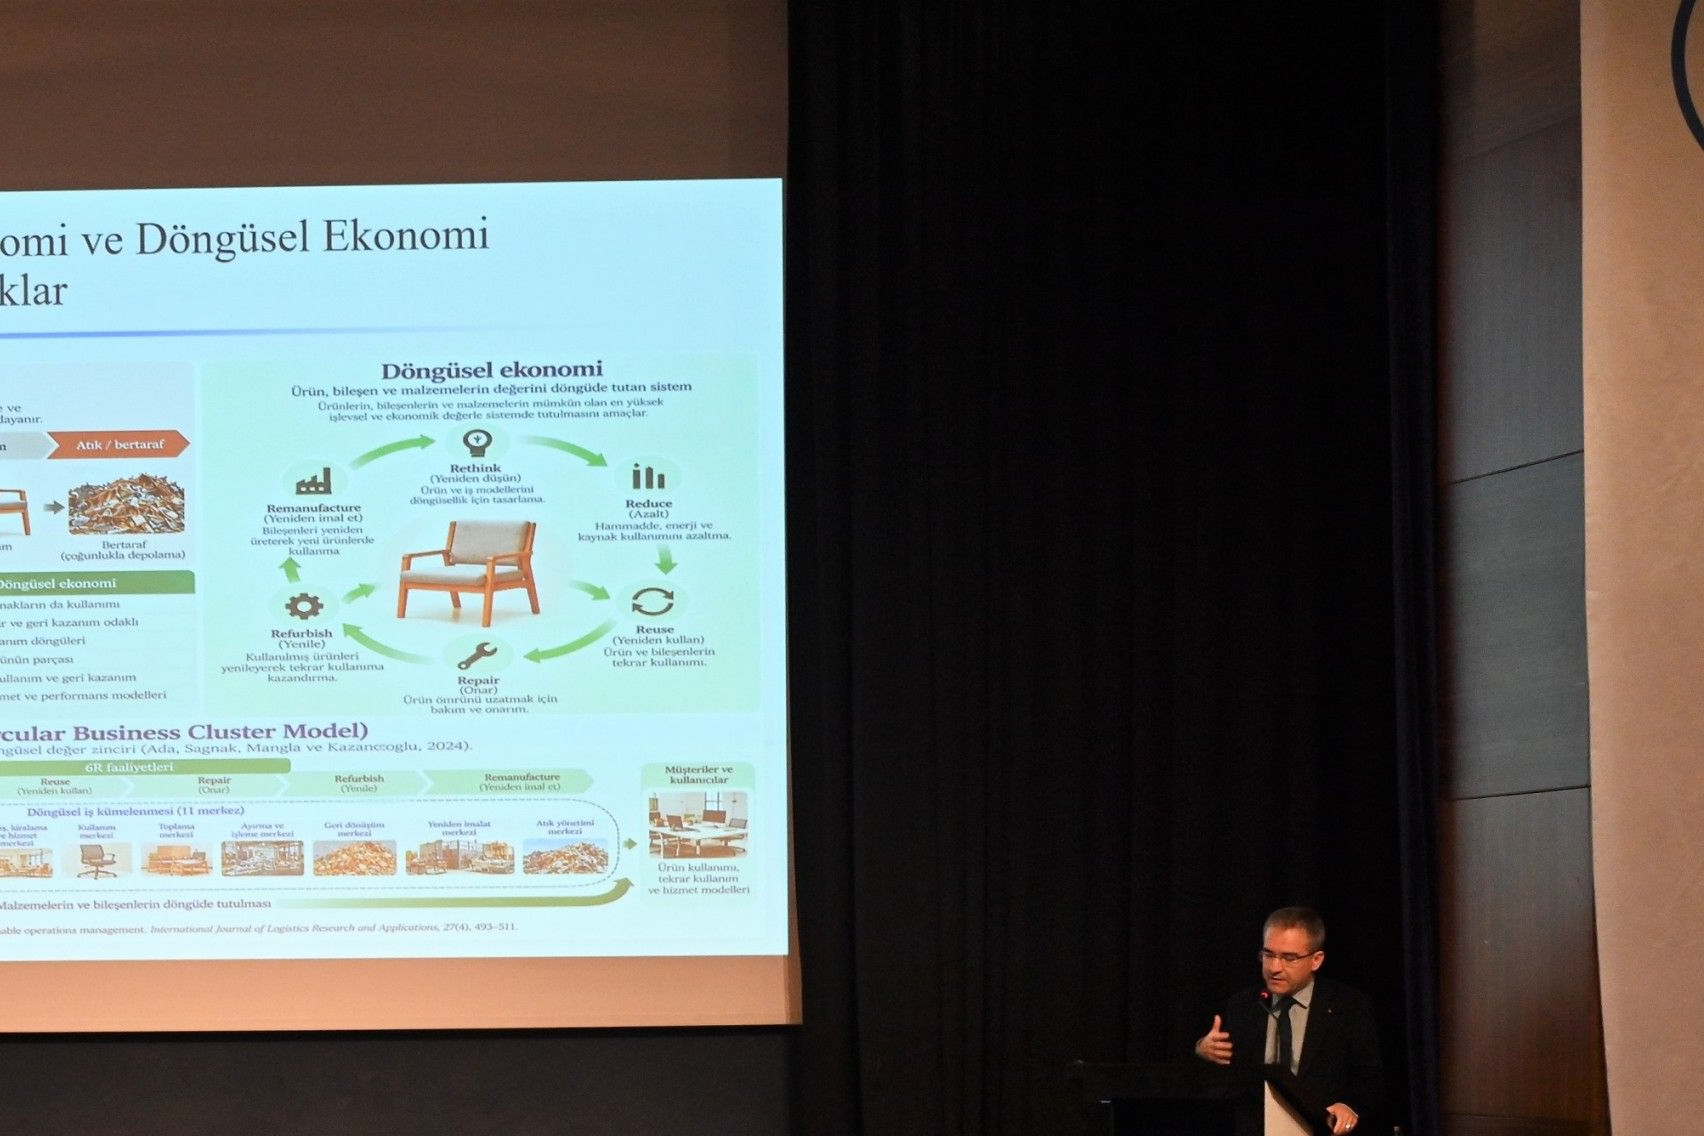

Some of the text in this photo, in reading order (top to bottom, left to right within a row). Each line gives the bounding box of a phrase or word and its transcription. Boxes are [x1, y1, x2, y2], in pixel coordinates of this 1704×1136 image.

[81, 233, 122, 255] ve
[136, 218, 309, 265] Döngüsel
[323, 215, 488, 252] Ekonomi
[382, 359, 603, 384] Döngüsel ekonomi
[291, 381, 692, 398] Ürün, bileşen ve malzemelerin değerini döngüde tutan sistem
[7, 405, 21, 413] ve
[76, 440, 102, 450] Atık
[114, 439, 165, 450] bertaraf
[450, 463, 501, 473] Rethink
[430, 473, 521, 484] (Yeniden düşün)
[267, 502, 361, 513] Remanufacture
[626, 498, 672, 508] Reduce
[263, 513, 363, 525] (Yeniden imal et)
[628, 509, 669, 519] (Azalt)
[102, 540, 147, 549] Bertaraf
[60, 549, 186, 562] (çoğunlukla depolama)
[58, 577, 116, 589] ekonomi
[271, 628, 332, 638] Refurbish
[636, 625, 674, 634] Reuse
[278, 639, 326, 650] (Yenile)
[612, 634, 704, 646] (Yeniden kullan)
[458, 675, 500, 687] Repair
[459, 685, 498, 696] (Onar)
[73, 724, 181, 741] Business
[187, 723, 276, 740] Cluster
[283, 721, 368, 742] Model)
[84, 761, 173, 774] 6R faaliyetleri
[665, 765, 719, 776] Müşteriler
[40, 777, 70, 786] Reuse
[197, 776, 231, 786] Repair
[334, 774, 384, 783] Refurbish
[484, 772, 560, 781] Remanufacture
[670, 774, 728, 784] kullanıcılar
[27, 807, 80, 819] Döngüsel
[84, 807, 93, 817] iş
[97, 806, 173, 816] kümelenmesi
[197, 805, 245, 816] merkez)
[93, 899, 160, 911] bileşenlerin
[163, 899, 214, 910] döngüde
[216, 898, 271, 908] tutulması
